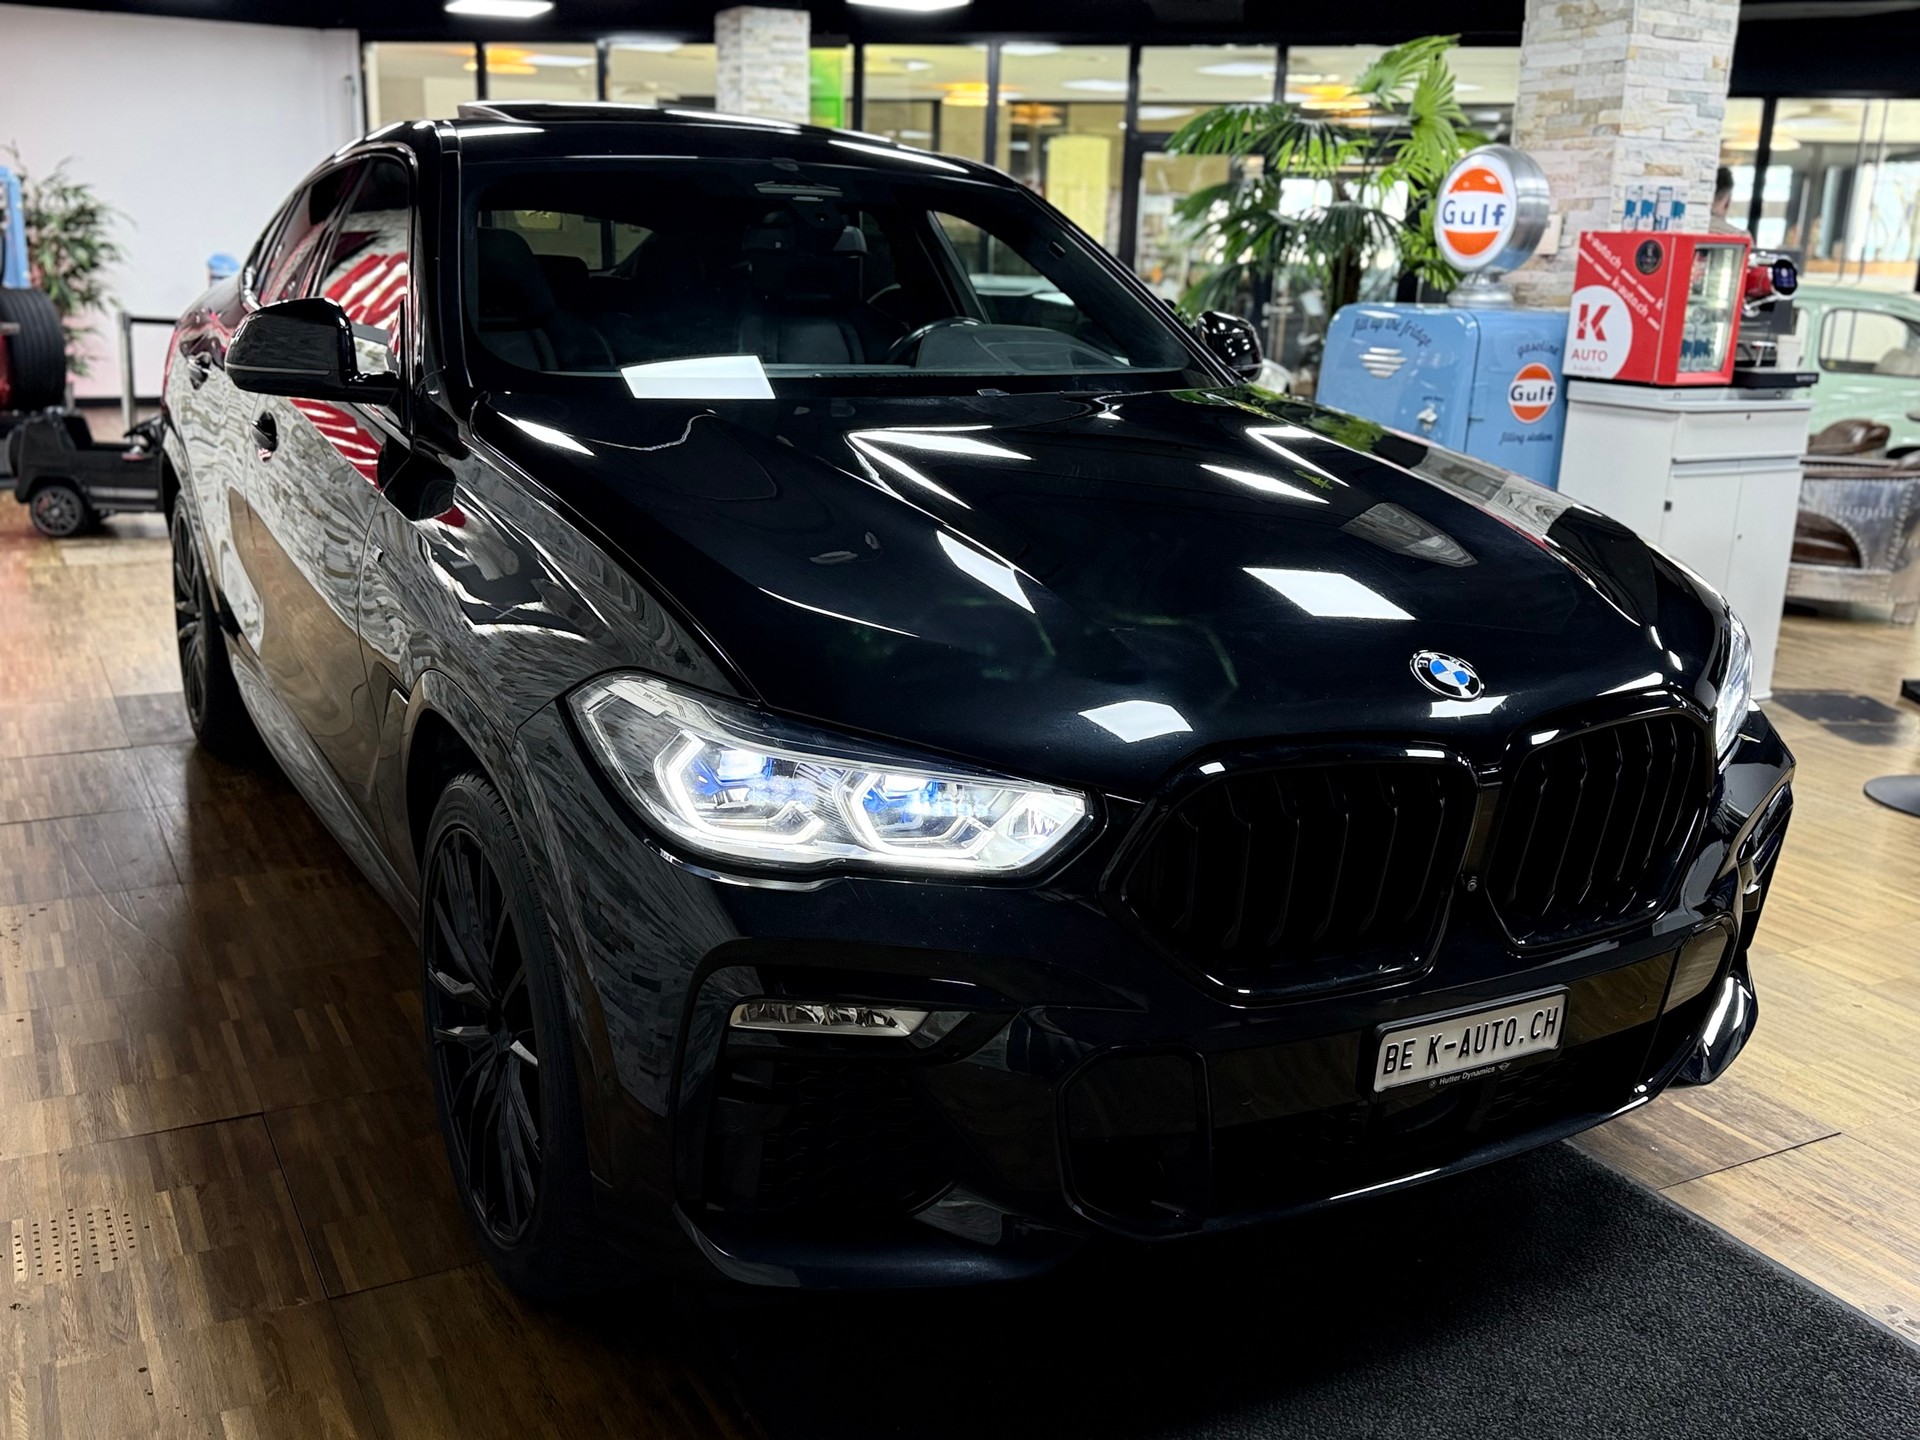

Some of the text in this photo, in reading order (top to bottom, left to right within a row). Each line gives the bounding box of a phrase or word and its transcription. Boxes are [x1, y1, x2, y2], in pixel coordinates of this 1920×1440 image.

[1442, 200, 1506, 226] Gulf
[1577, 304, 1610, 341] K
[1571, 348, 1608, 362] AUTO
[1510, 385, 1554, 402] Gulf
[1383, 1007, 1559, 1074] BE K-AUTO.CH
[1439, 1066, 1496, 1085] Hutter Dynamics
